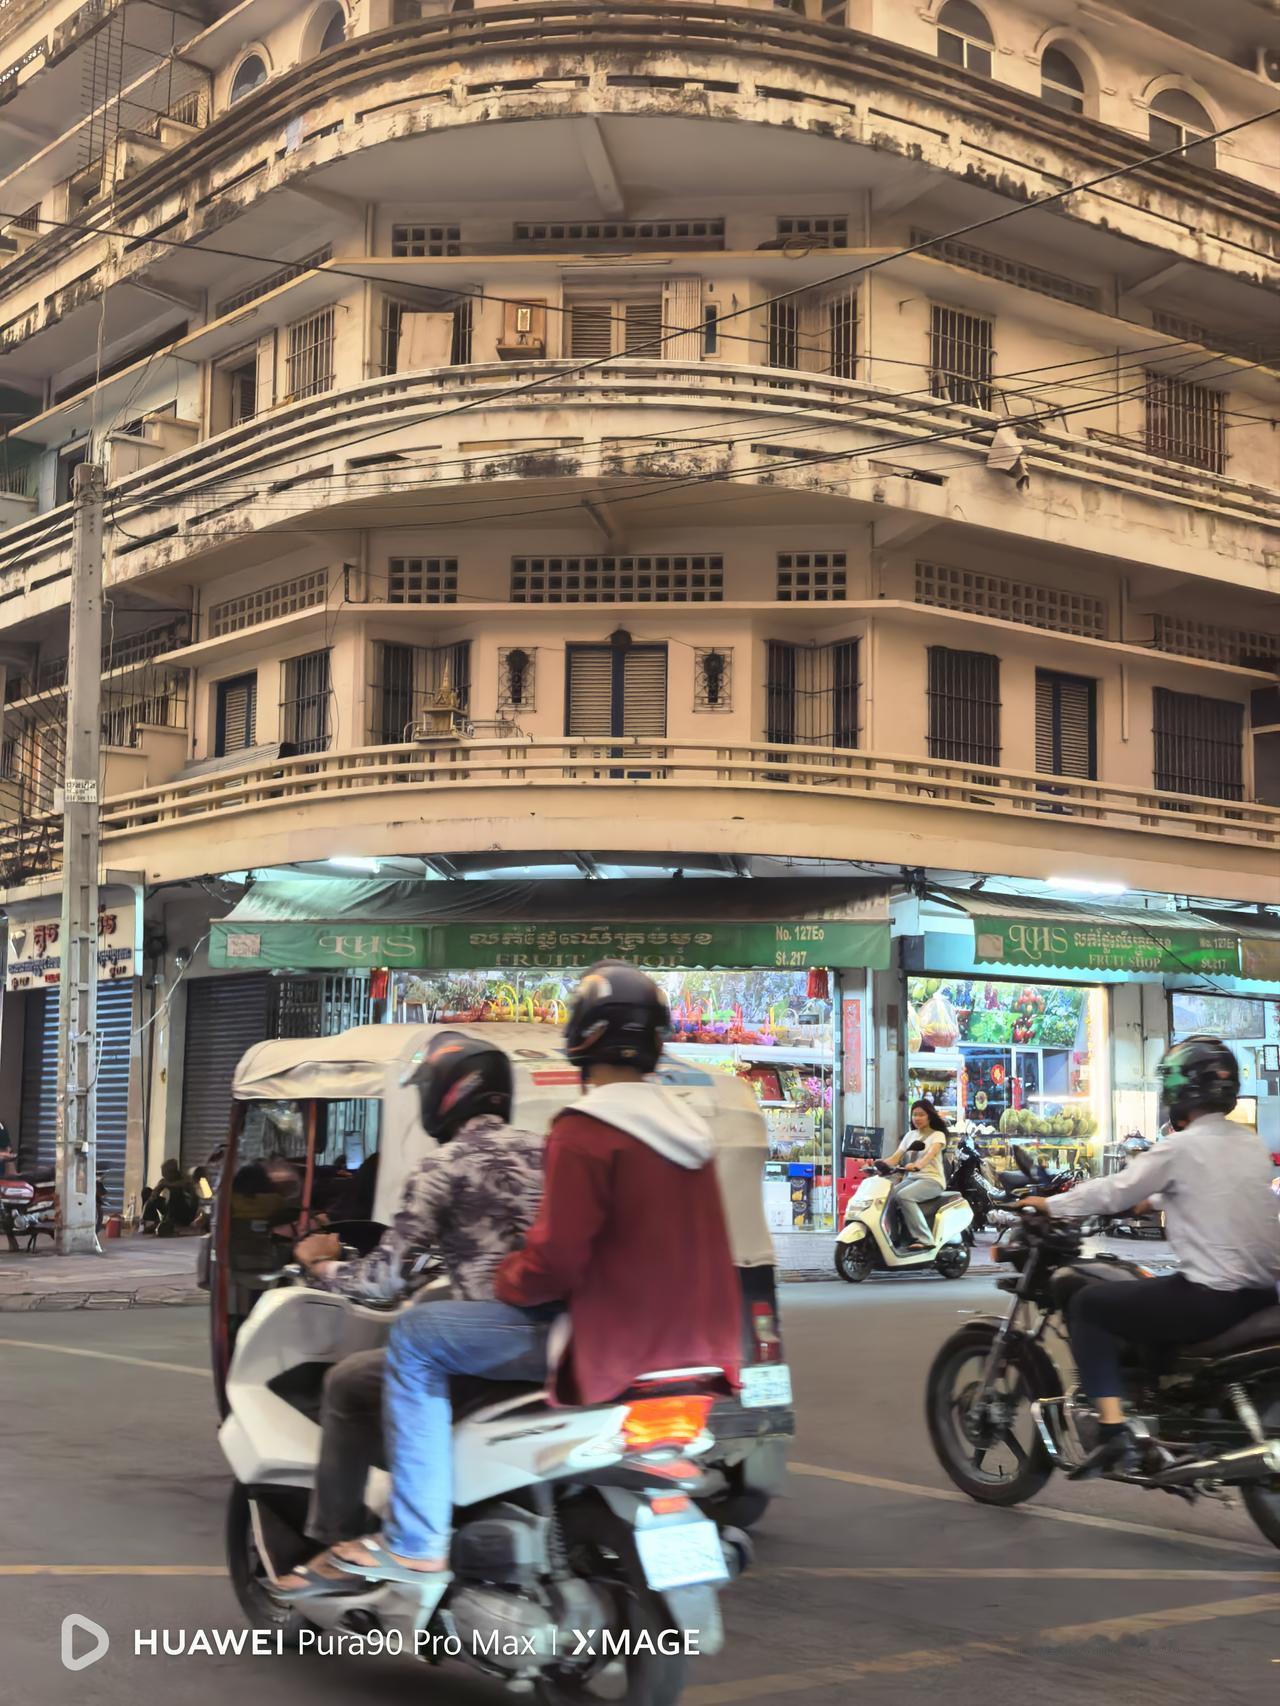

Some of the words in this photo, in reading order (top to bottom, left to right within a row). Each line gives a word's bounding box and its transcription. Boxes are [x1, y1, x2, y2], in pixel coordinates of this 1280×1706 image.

[775, 925, 792, 941] No.
[495, 953, 585, 966] FRUIT
[1088, 953, 1125, 967] FRUIT
